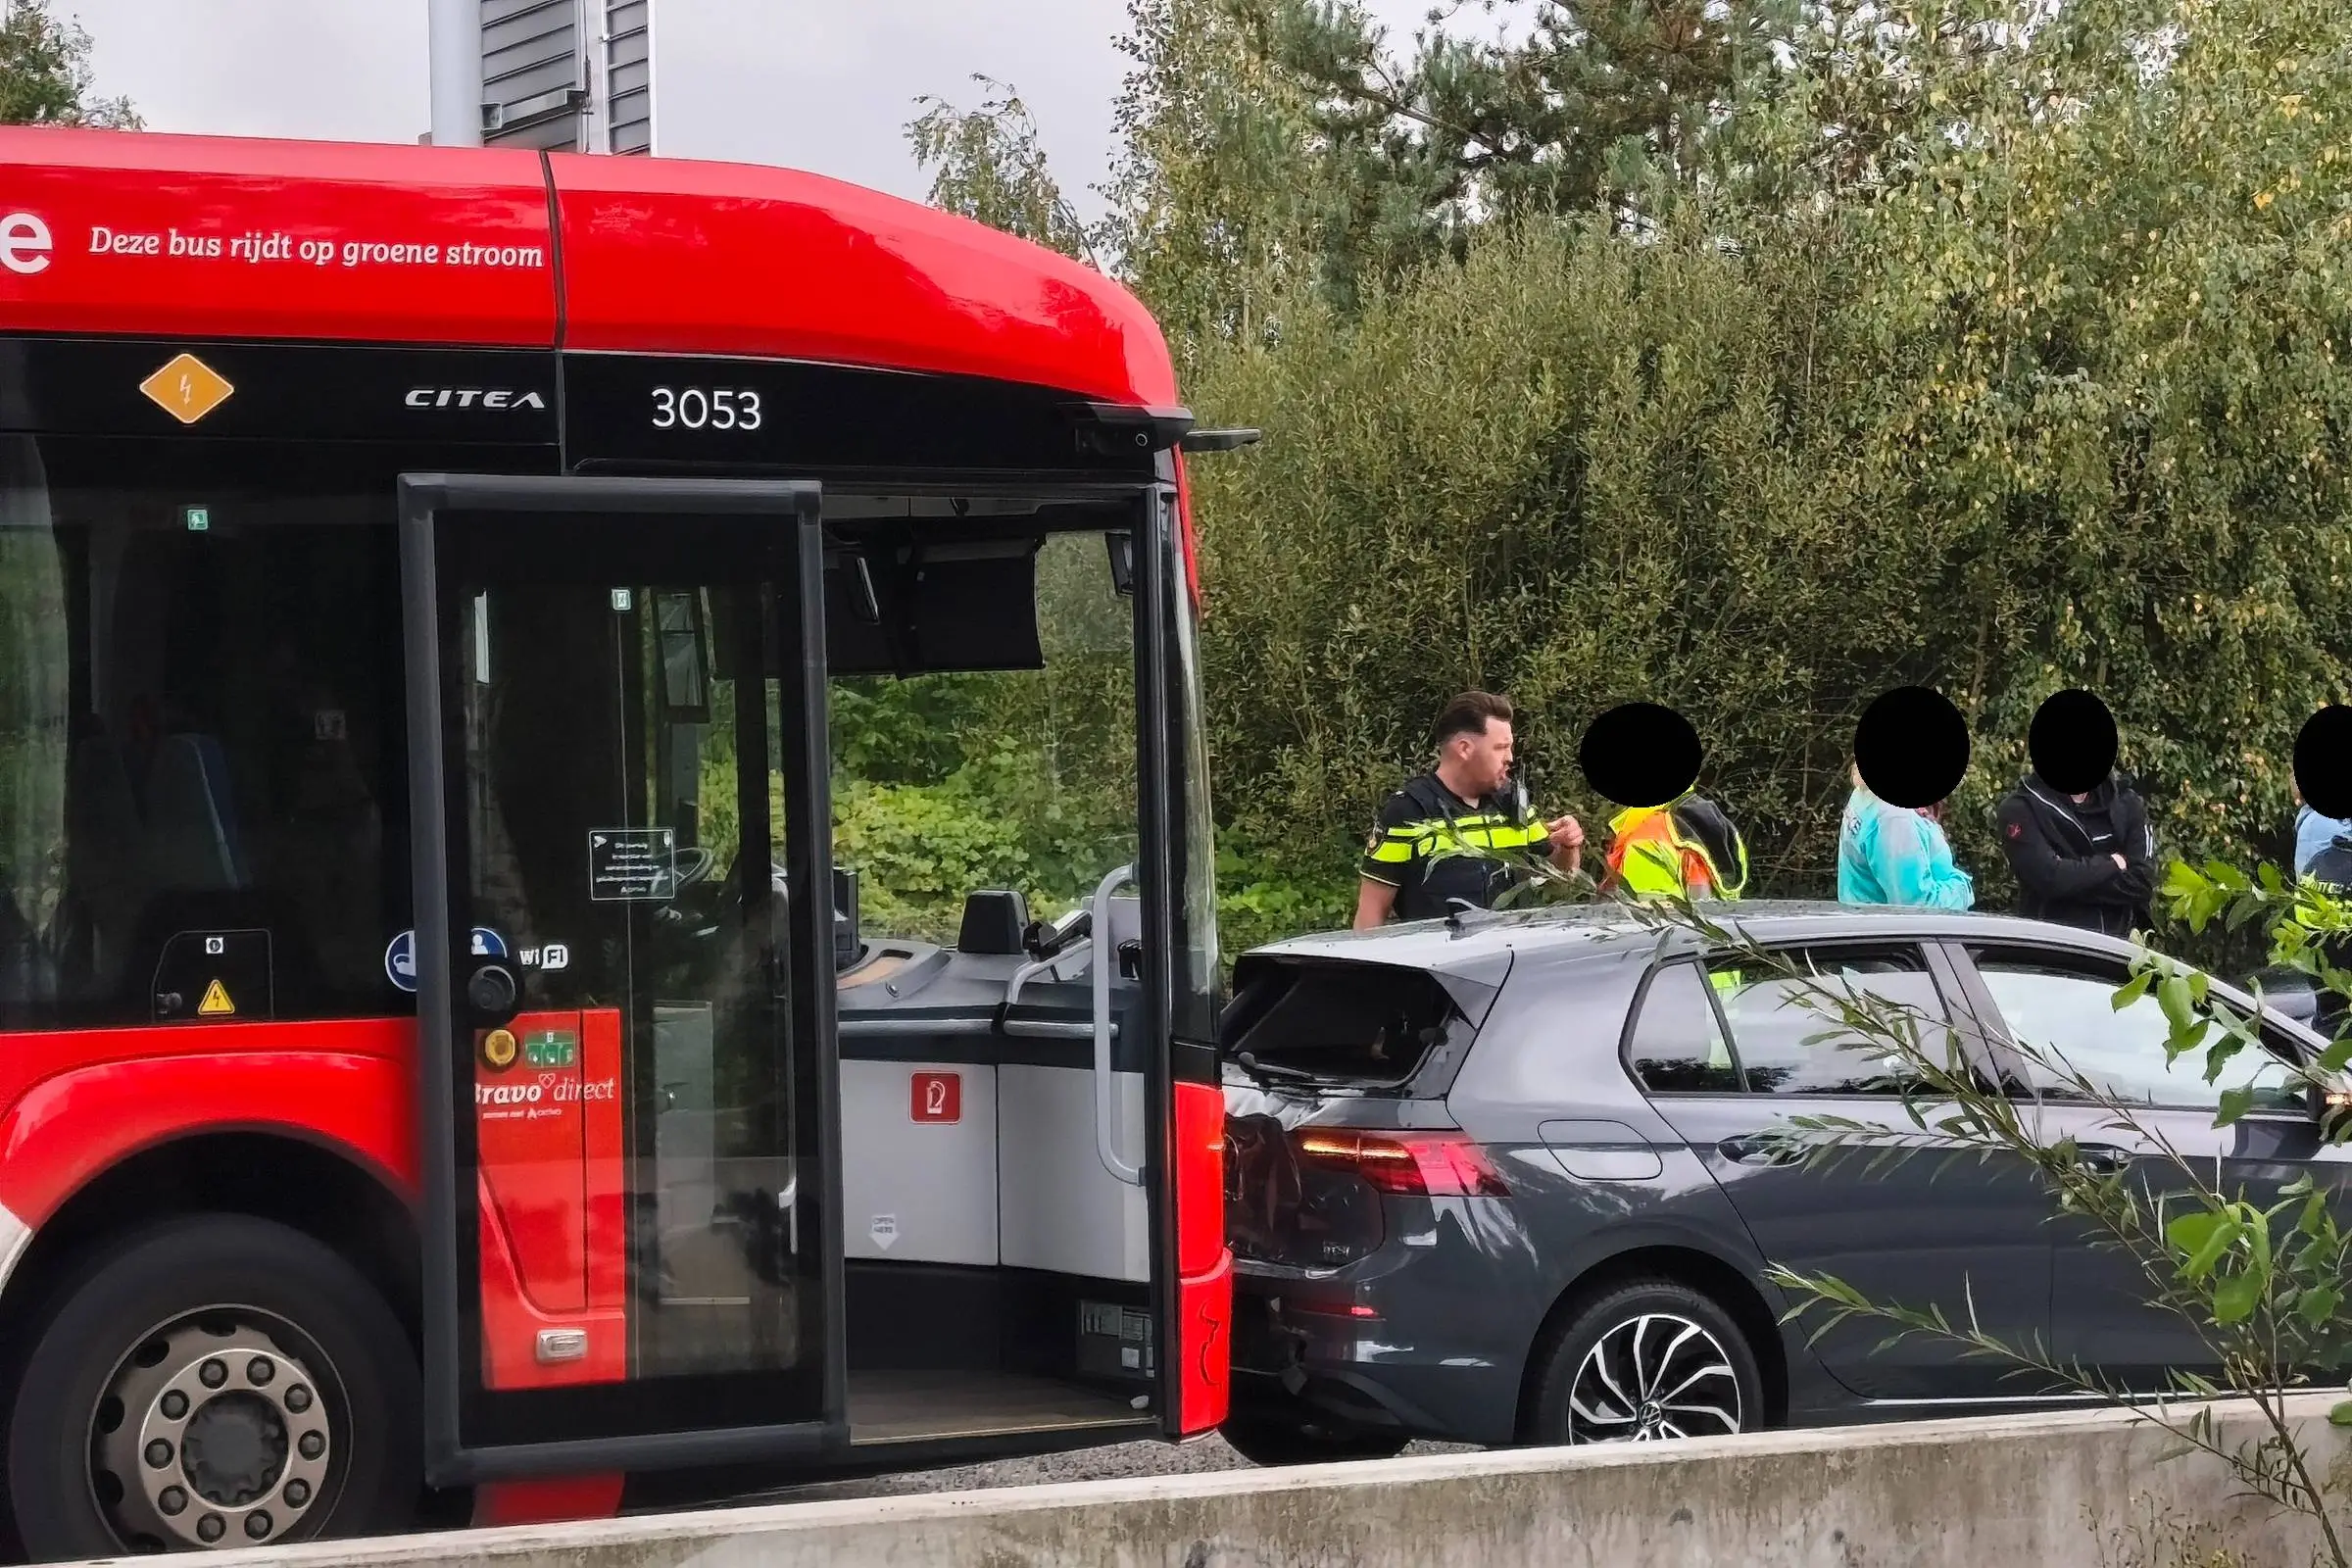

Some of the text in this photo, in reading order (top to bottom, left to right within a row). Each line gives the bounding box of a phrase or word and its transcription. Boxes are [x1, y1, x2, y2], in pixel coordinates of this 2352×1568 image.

[89, 227, 543, 268] Deze bus rijdt op groene stroom
[405, 389, 546, 409] CITEA
[651, 388, 761, 430] 3053
[554, 1077, 614, 1102] direct
